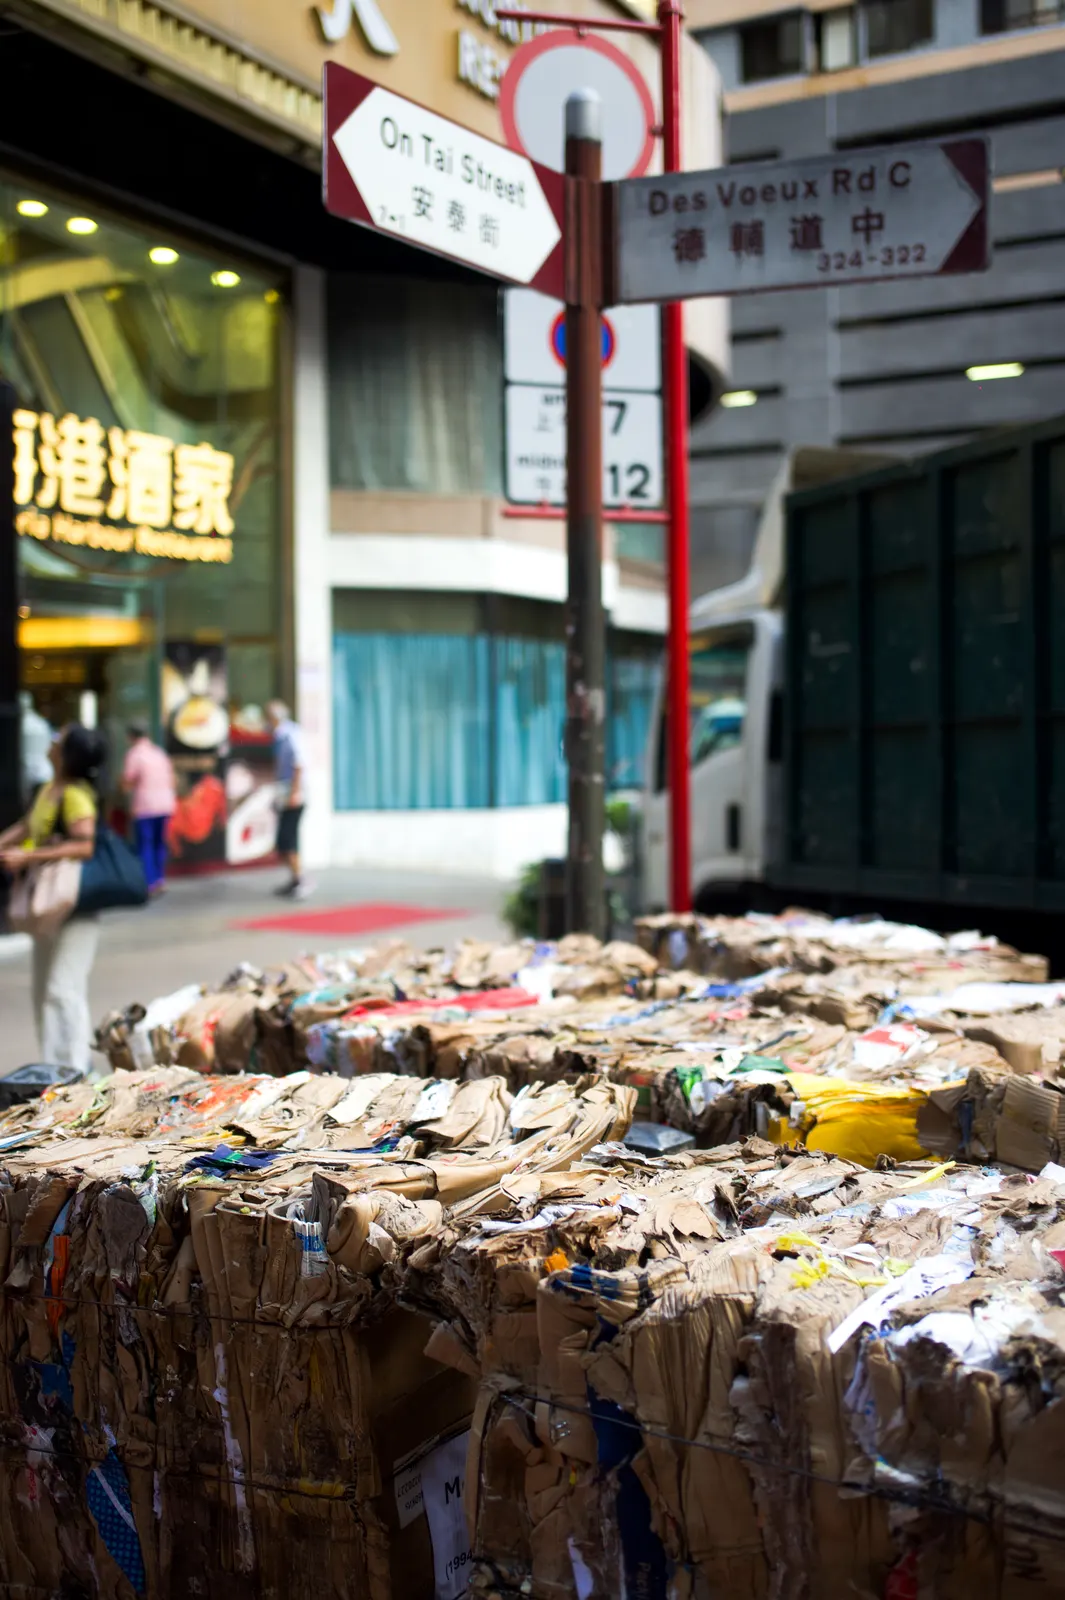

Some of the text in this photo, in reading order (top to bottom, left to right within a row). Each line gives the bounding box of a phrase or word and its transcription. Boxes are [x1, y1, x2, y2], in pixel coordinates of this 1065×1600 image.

[380, 116, 526, 208] On Tai Street
[648, 160, 911, 217] Des Voeux Rd C
[818, 243, 927, 273] 324-322
[602, 400, 627, 436] 7
[606, 463, 652, 499] 12
